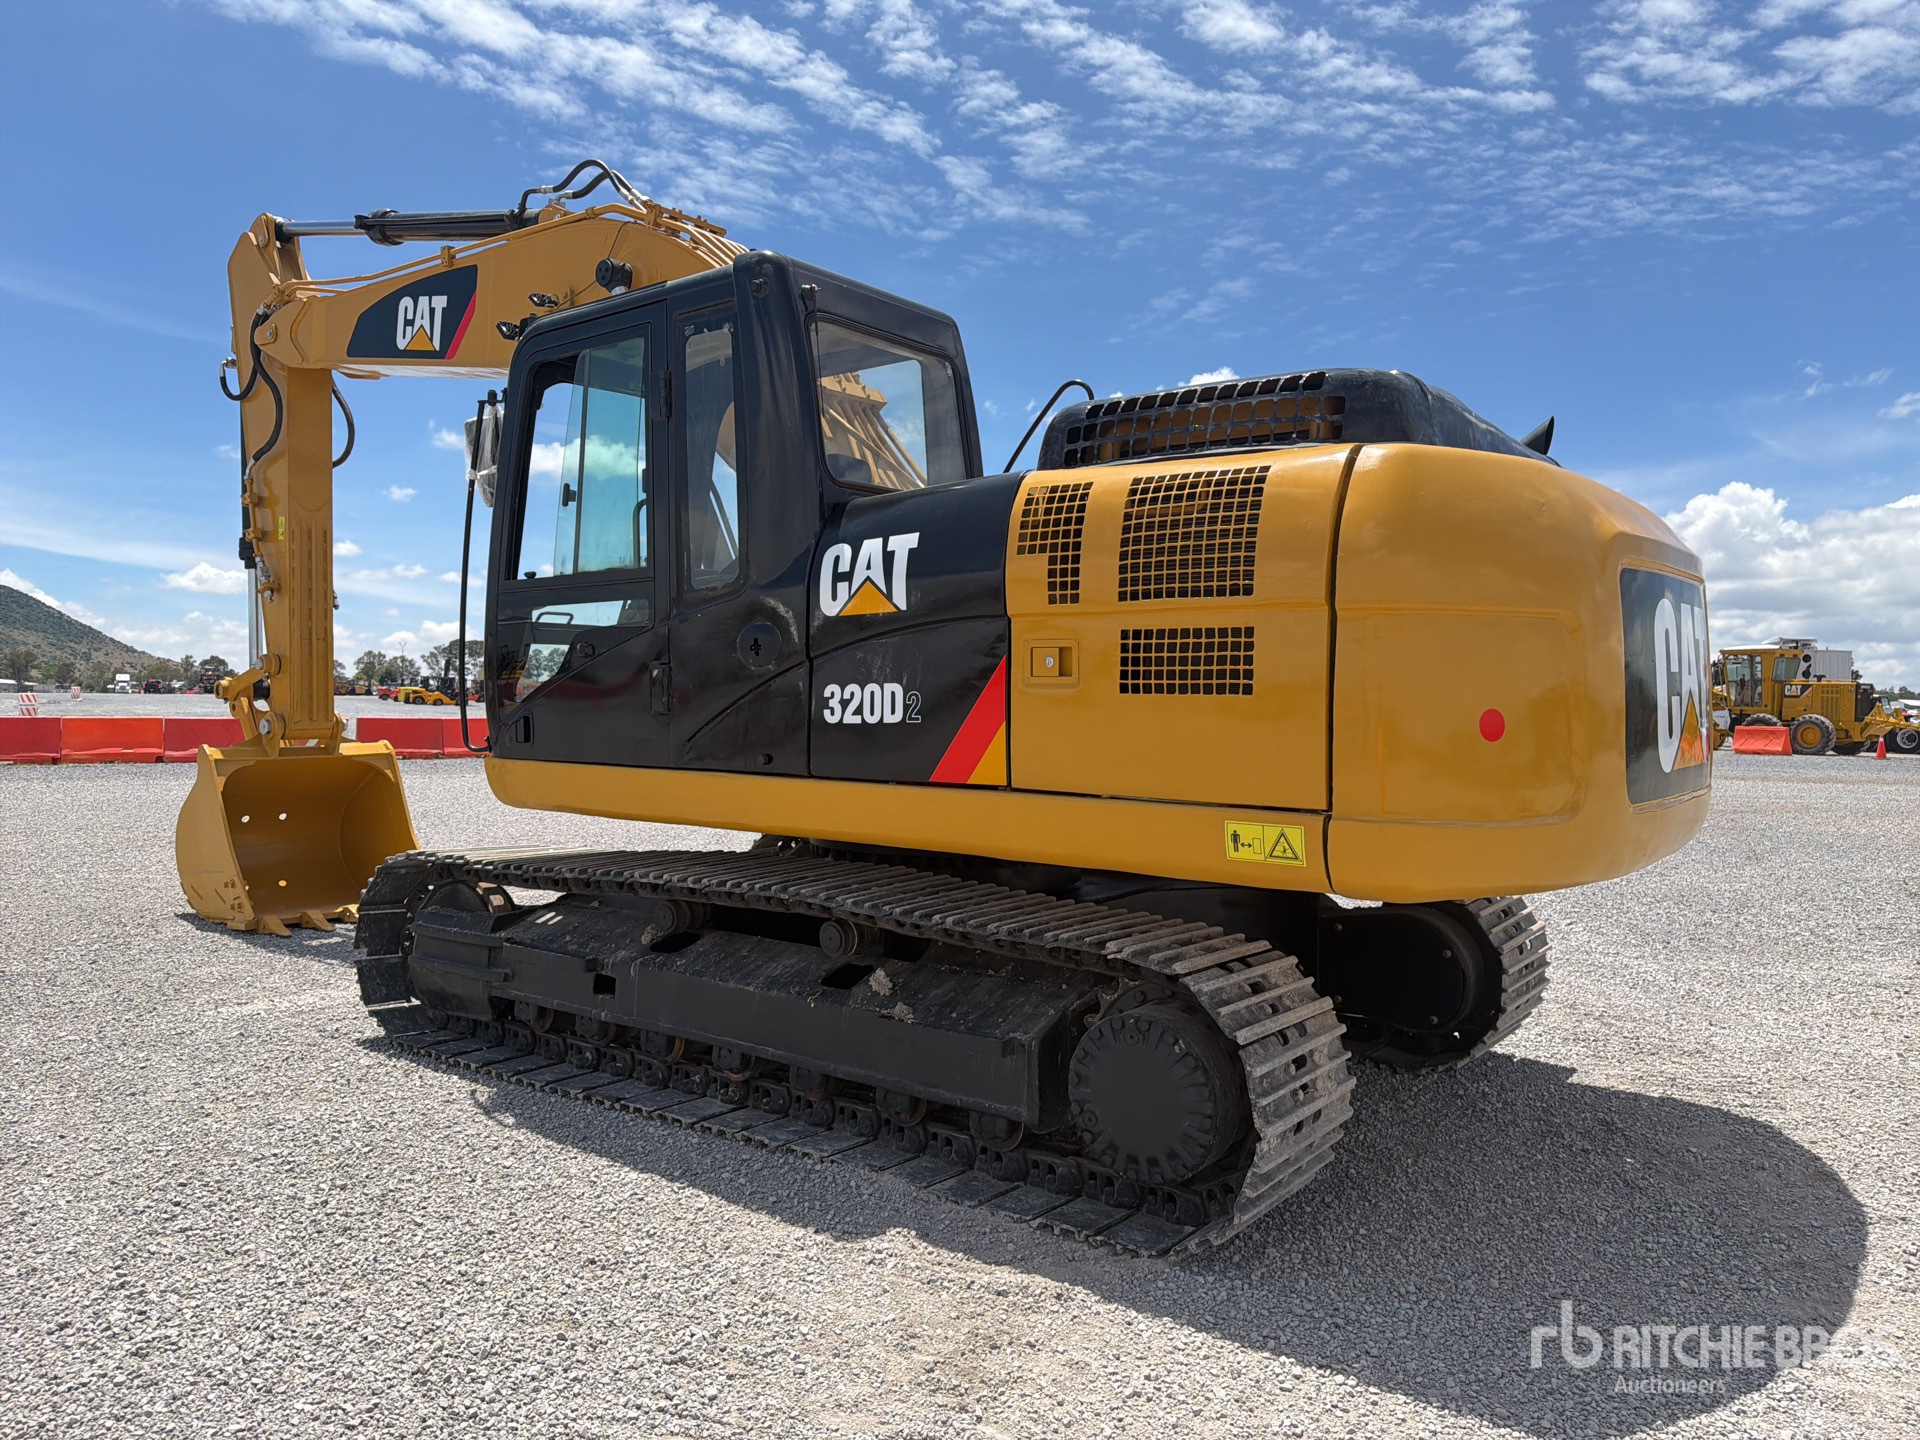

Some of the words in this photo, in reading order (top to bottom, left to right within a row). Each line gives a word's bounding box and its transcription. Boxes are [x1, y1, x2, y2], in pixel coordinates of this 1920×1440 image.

[396, 295, 448, 351] CAT
[819, 532, 920, 616] CAT
[1784, 684, 1802, 696] CAT
